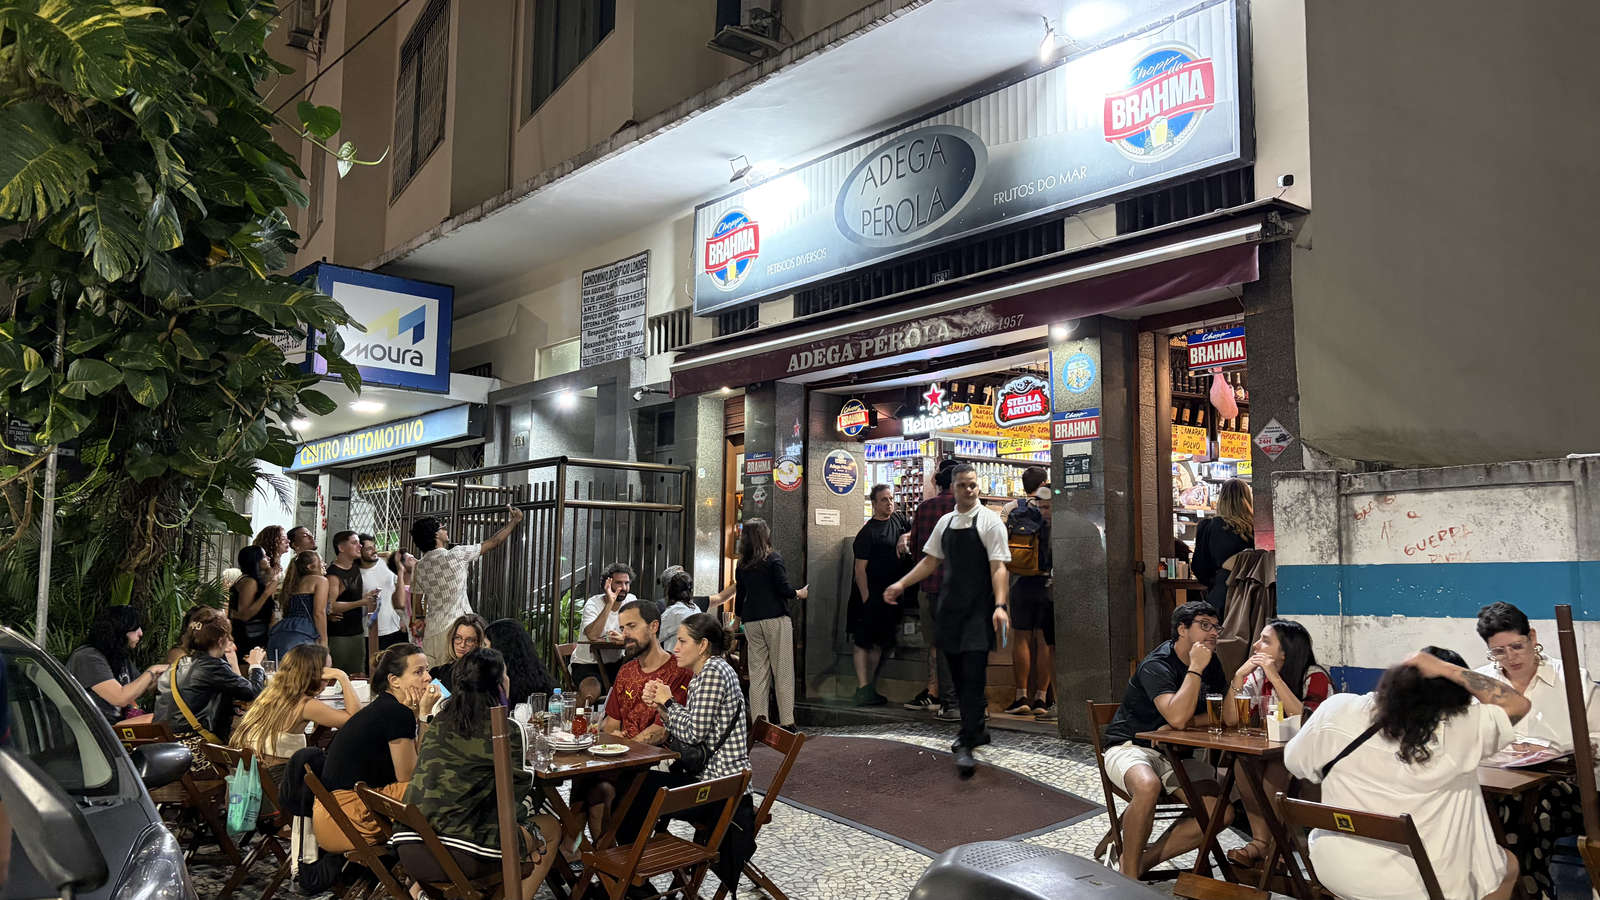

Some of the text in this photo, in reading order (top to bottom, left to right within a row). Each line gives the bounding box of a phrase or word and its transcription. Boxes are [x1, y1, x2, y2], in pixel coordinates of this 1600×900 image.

[1111, 68, 1206, 130] BRAHMA
[861, 135, 947, 195] ADEGA
[993, 166, 1088, 207] FRUTOS DO MAR
[861, 185, 947, 237] PÉROLA
[708, 228, 756, 267] BRAHMA
[796, 247, 827, 267] DIVERSOS
[786, 314, 1024, 373] ADEGA PÉROLA Desde 1957
[1190, 340, 1244, 365] BRAHMA
[1006, 402, 1042, 416] ARTOIS
[1007, 394, 1041, 407] STELLA
[841, 411, 866, 427] BRAHMA
[902, 408, 971, 435] Heineken
[1055, 420, 1097, 439] BRAHMA
[300, 419, 424, 465] CENTRO AUTOMOTIVO
[746, 460, 771, 473] BRAHMA
